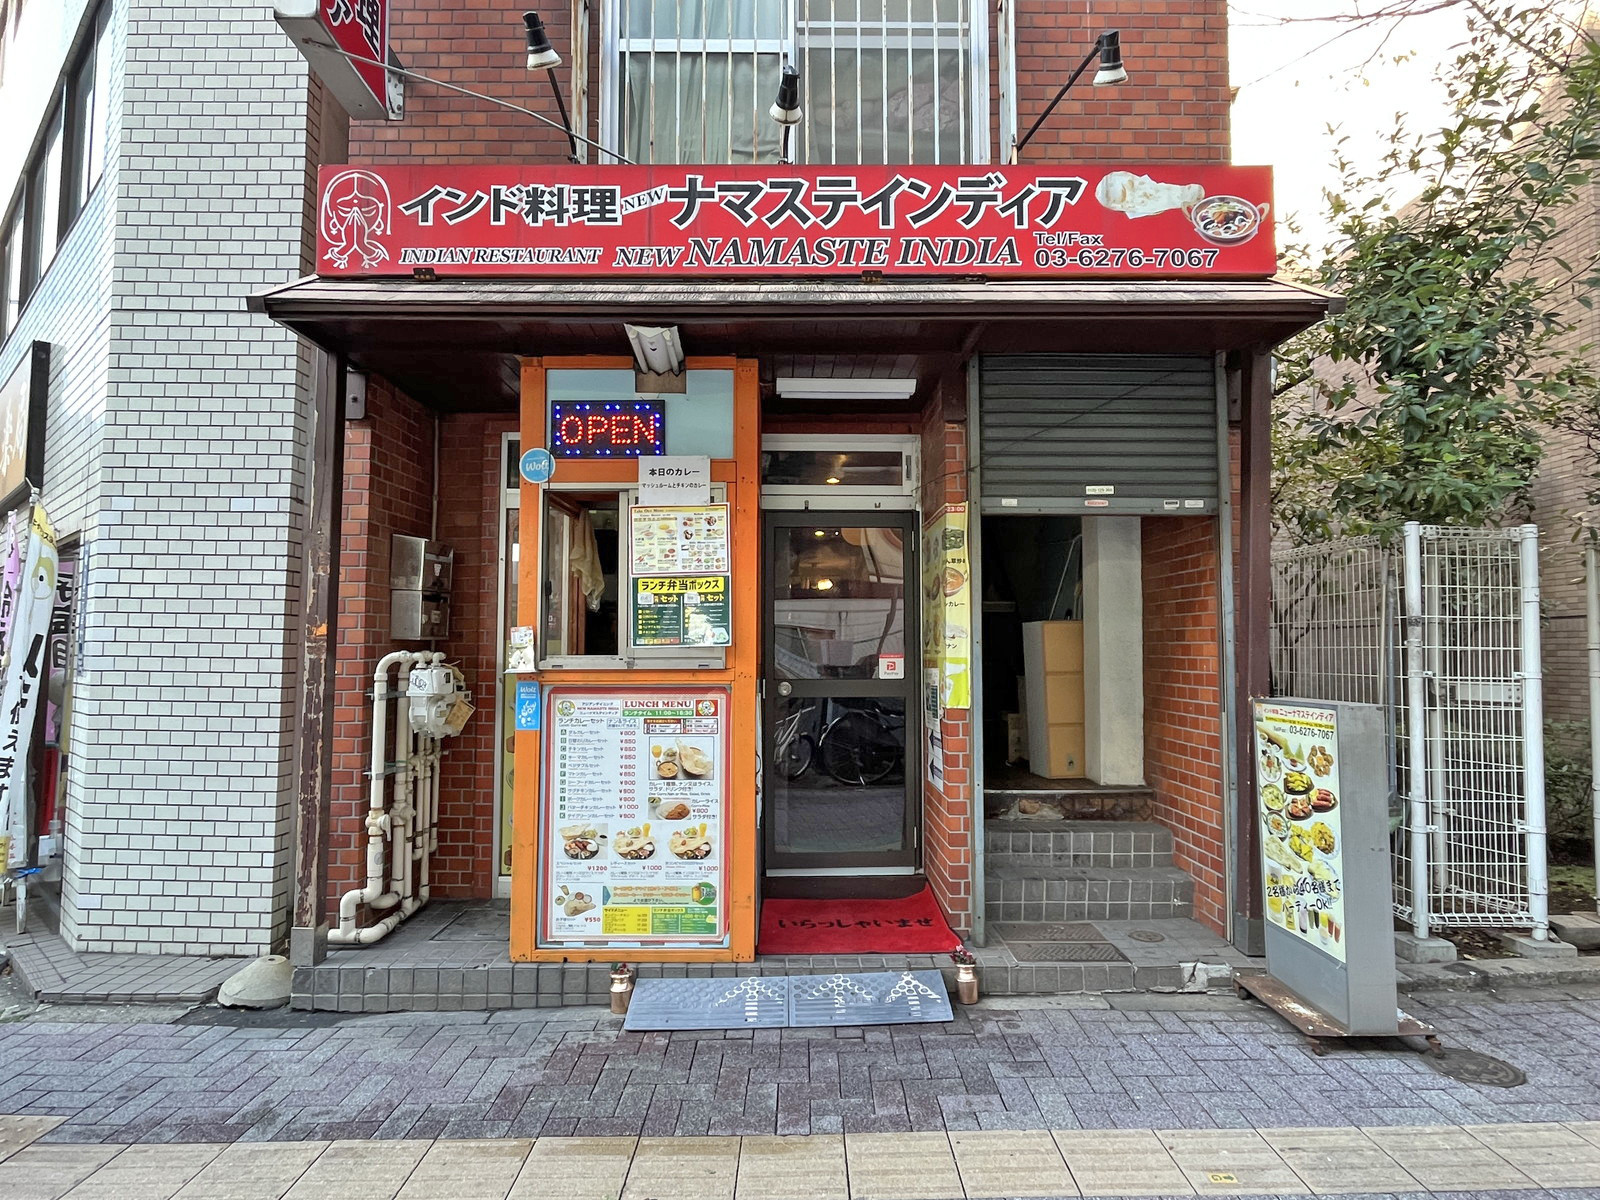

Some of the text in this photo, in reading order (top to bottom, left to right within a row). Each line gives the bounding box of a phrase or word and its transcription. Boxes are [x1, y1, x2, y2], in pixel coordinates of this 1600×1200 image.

[397, 184, 622, 226] インド料理
[621, 187, 667, 214] NEW
[668, 173, 1087, 230] ナマステインディア
[1034, 231, 1104, 247] Tel/Fax
[400, 247, 603, 264] INDIAN RESTAURANT
[614, 236, 1020, 267] NEW NAMASTE INDIA
[1034, 248, 1220, 268] 03-6276-7067
[561, 415, 655, 445] OPEN
[649, 468, 700, 476] 本日のカレー
[641, 579, 720, 591] ランチ弁当ボックス
[624, 700, 691, 708] LUNCH MENU
[1290, 725, 1334, 740] 03-6276-7067
[779, 919, 933, 928] いらっしゃいませ
